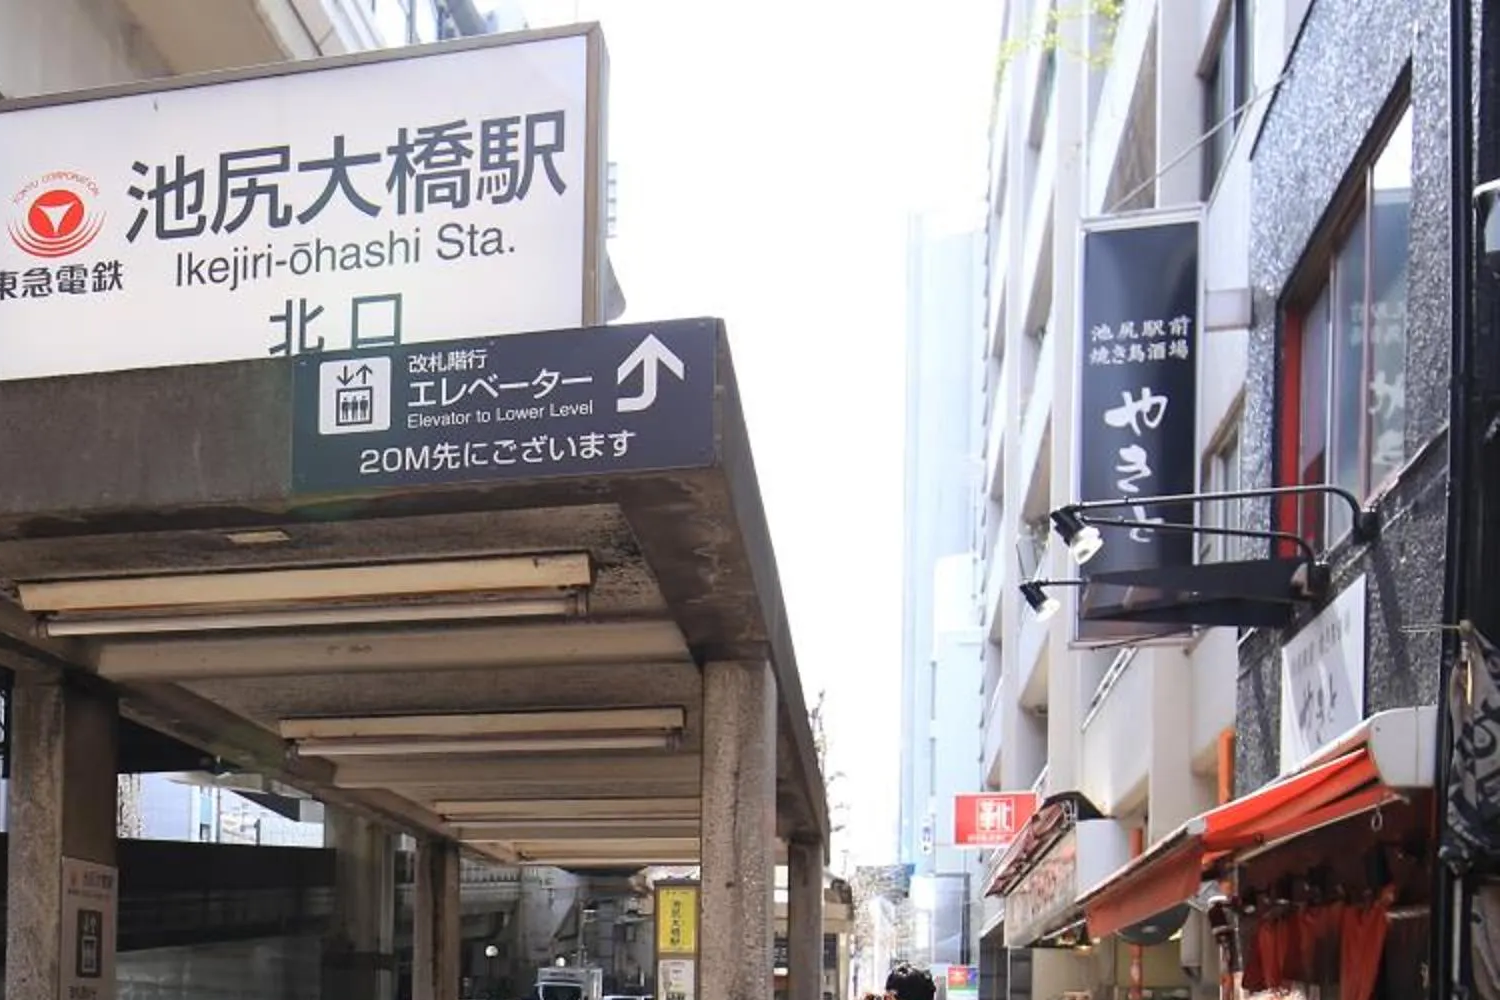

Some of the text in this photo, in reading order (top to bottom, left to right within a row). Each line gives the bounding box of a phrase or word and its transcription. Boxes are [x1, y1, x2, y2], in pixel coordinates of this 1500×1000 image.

[125, 109, 568, 244] 池尻大橋駅
[175, 223, 516, 292] Ikejiri-ōhashi Sta.
[269, 293, 403, 356] 北口
[408, 349, 488, 374] 改札階行
[407, 368, 593, 408] エレベーター
[407, 400, 594, 429] Elevator to Lower Level
[359, 429, 637, 475] 20M先にございます
